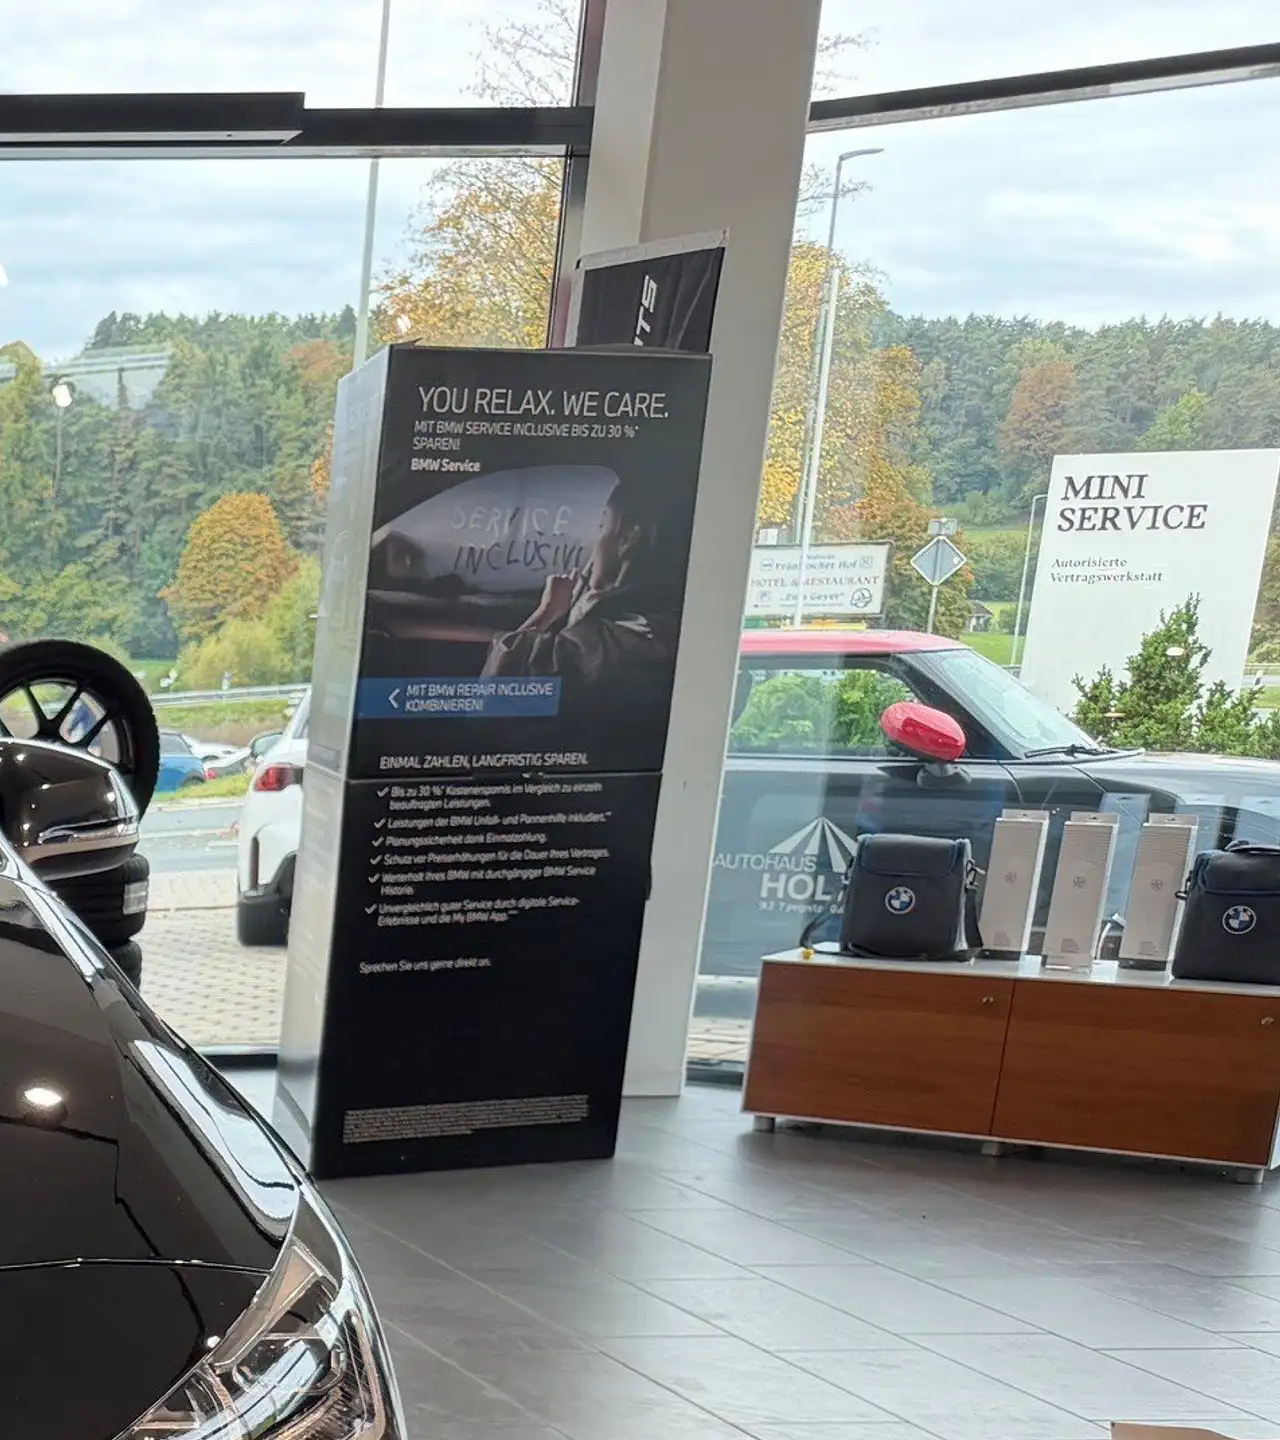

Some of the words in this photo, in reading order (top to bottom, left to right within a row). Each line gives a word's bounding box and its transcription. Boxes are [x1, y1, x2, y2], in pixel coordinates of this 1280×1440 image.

[418, 386, 468, 414] YOU
[475, 388, 555, 416] RELAX.
[564, 391, 599, 417] WE
[604, 392, 669, 419] CARE.
[414, 421, 435, 433] MIT
[437, 421, 465, 434] BMW
[466, 422, 511, 436] SERVICE
[513, 423, 569, 437] INCLUSIVE
[571, 424, 589, 437] BIS
[591, 425, 606, 438] ZU
[608, 425, 622, 438] 30
[413, 437, 460, 451] SPAREN!
[411, 458, 441, 471] BMW
[441, 459, 481, 472] Service
[1061, 474, 1149, 500] MINI
[1057, 504, 1208, 532] SERVICE
[1052, 557, 1127, 569] Autorisierte
[1051, 571, 1163, 585] Vertragswerkstatt
[406, 685, 427, 697] MIT
[428, 685, 455, 697] BMW
[457, 684, 495, 696] REPAIR
[497, 682, 553, 696] INCLUSIVE
[380, 755, 421, 769] EINMAL
[424, 754, 470, 769] ZAHLEN,
[472, 753, 543, 767] LANGFRISTIG
[544, 752, 588, 766] SPAREN.
[713, 853, 818, 873] AUTOHAUS
[760, 872, 842, 902] HOL
